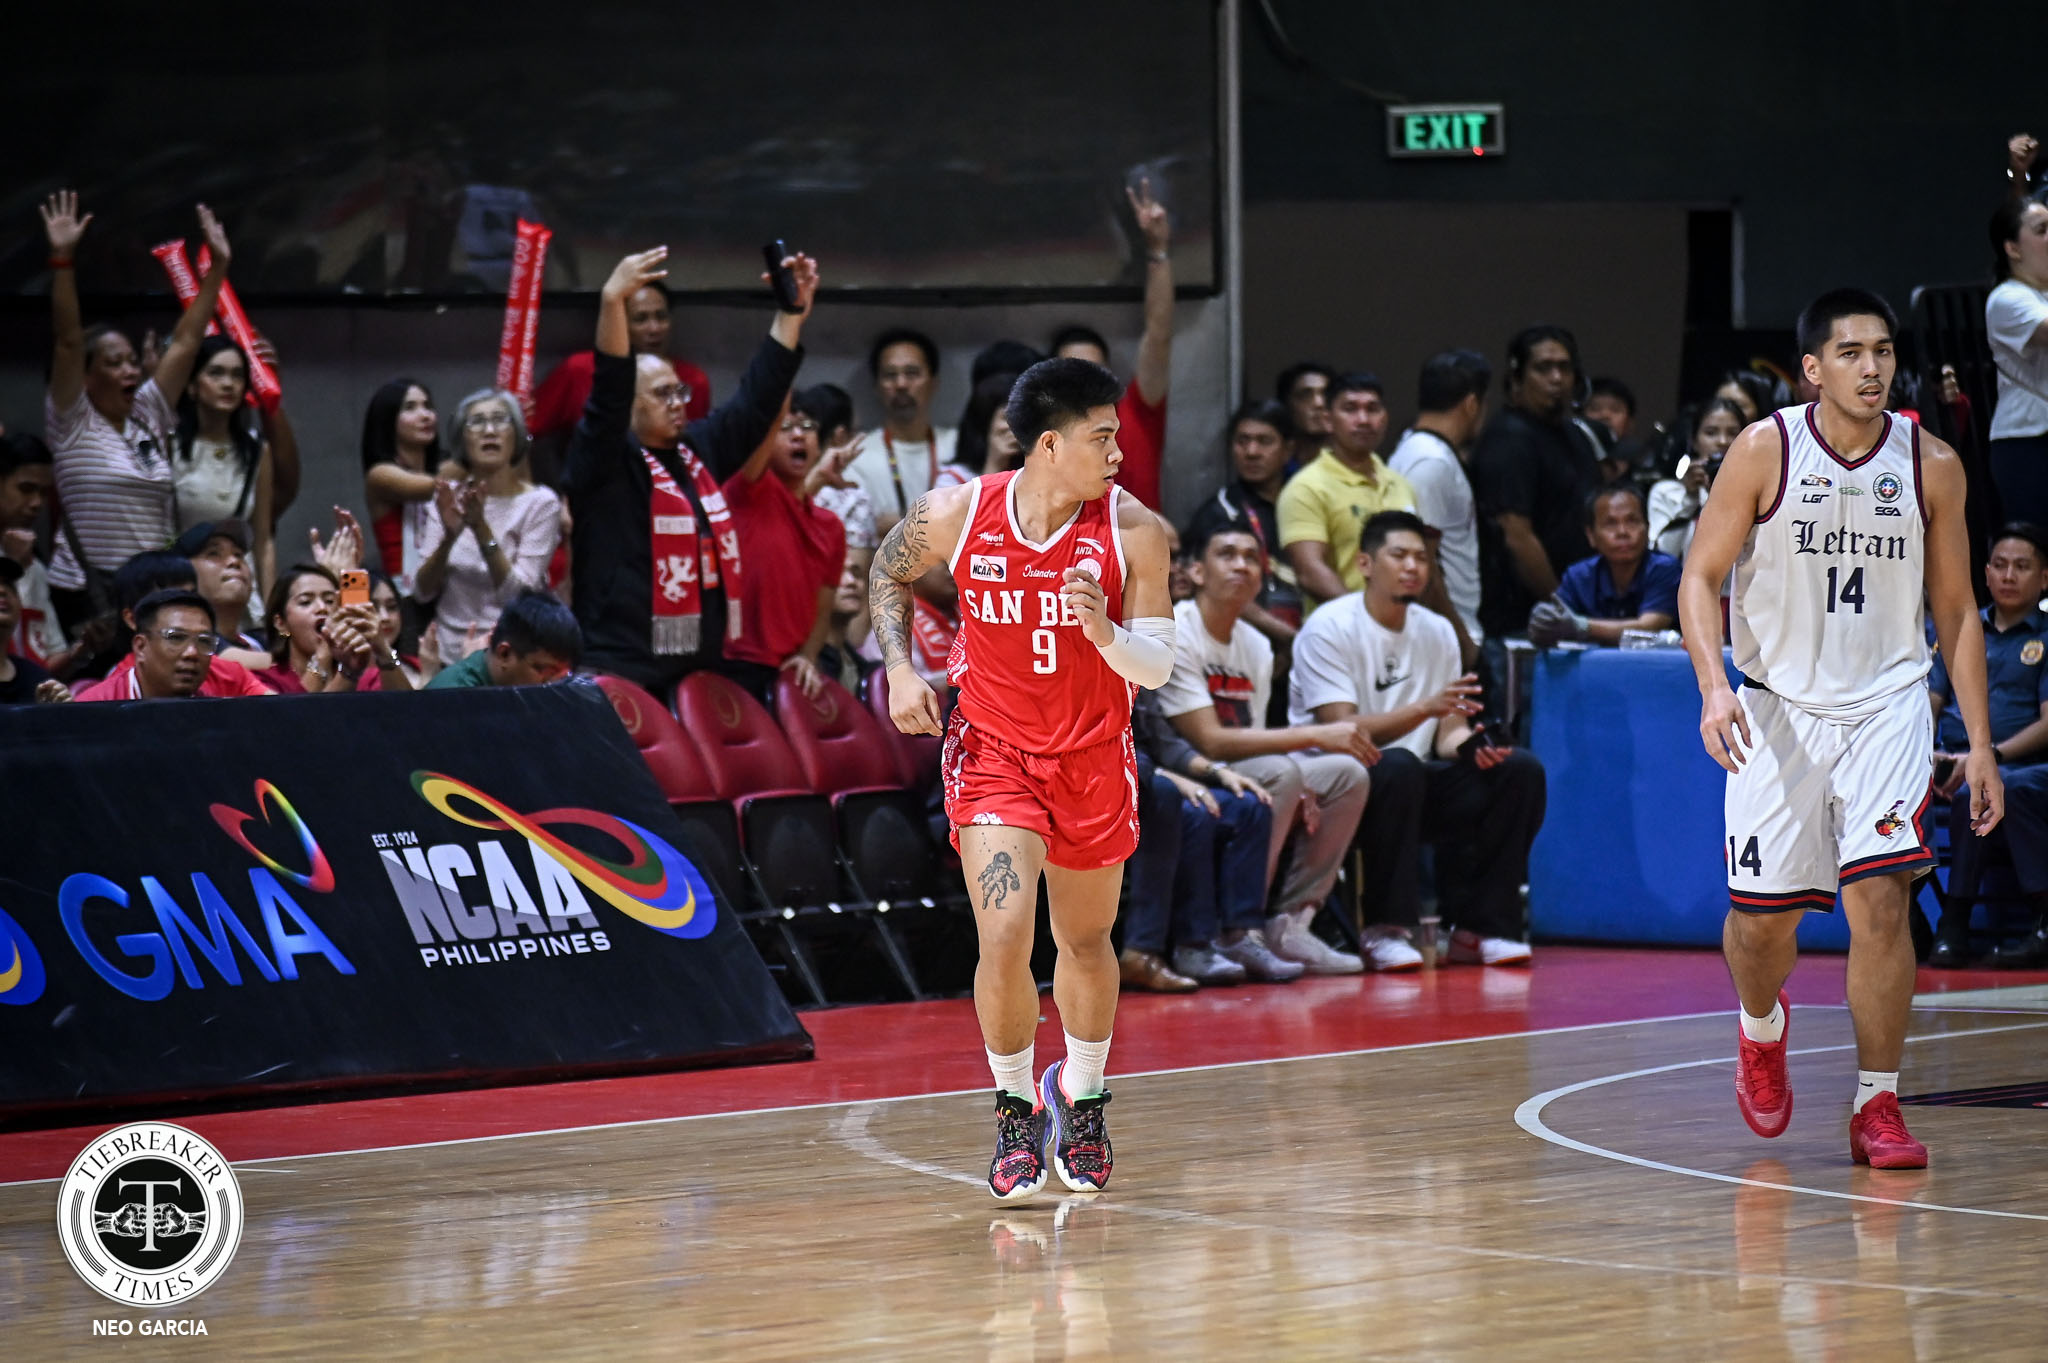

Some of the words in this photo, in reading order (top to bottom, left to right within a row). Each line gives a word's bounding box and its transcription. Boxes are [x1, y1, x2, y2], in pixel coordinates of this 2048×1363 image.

[1405, 112, 1487, 150] EXIT
[1874, 506, 1902, 516] SGA
[1074, 546, 1093, 556] ANTA
[1791, 519, 1907, 560] Letran
[972, 564, 992, 577] NCAA
[1826, 566, 1865, 614] 14
[964, 588, 1025, 625] SAN
[1038, 590, 1109, 627] BE
[1031, 628, 1057, 674] 9
[371, 833, 393, 848] EST.
[394, 830, 419, 846] 1924
[1728, 835, 1762, 878] 14
[378, 837, 601, 945] NCAA
[57, 866, 357, 1001] GMA
[419, 931, 612, 968] PHILIPPINES
